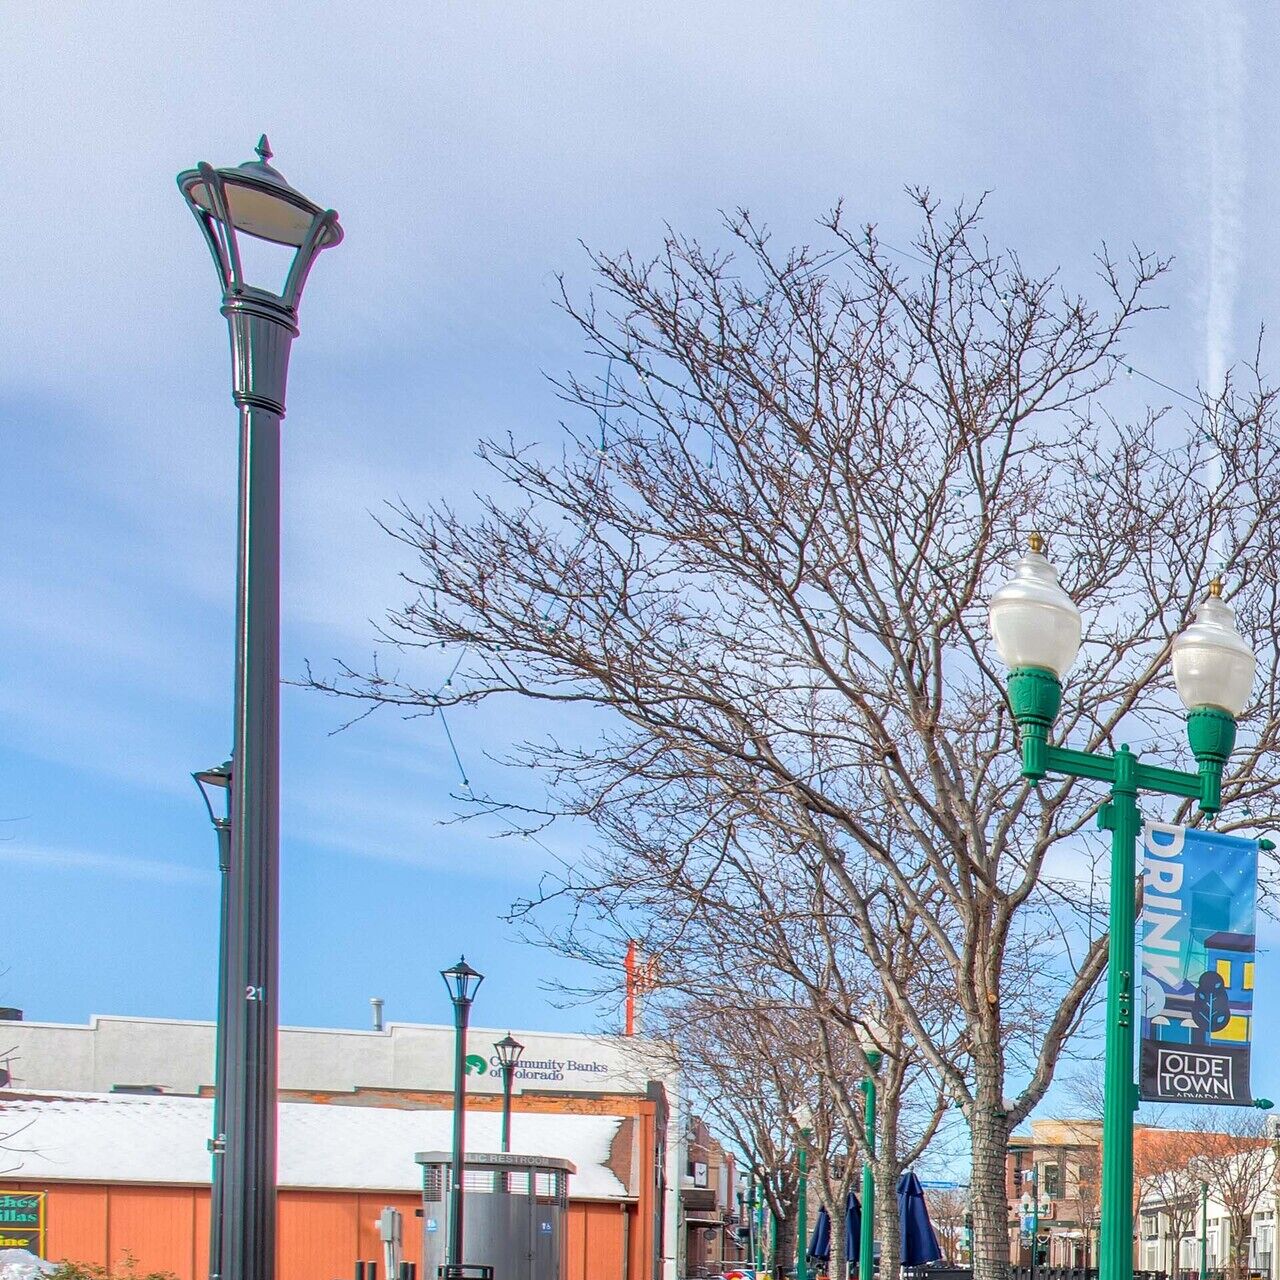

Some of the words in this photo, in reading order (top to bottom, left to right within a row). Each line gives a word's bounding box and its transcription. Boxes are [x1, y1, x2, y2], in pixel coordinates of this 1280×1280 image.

[1142, 823, 1186, 991] DRINK
[246, 985, 263, 1001] 21
[567, 1060, 608, 1073] Banks
[1165, 1054, 1223, 1077] OLDE
[514, 1068, 564, 1081] olorado
[1161, 1073, 1229, 1094] TOWN
[489, 1155, 549, 1165] RESTROOM
